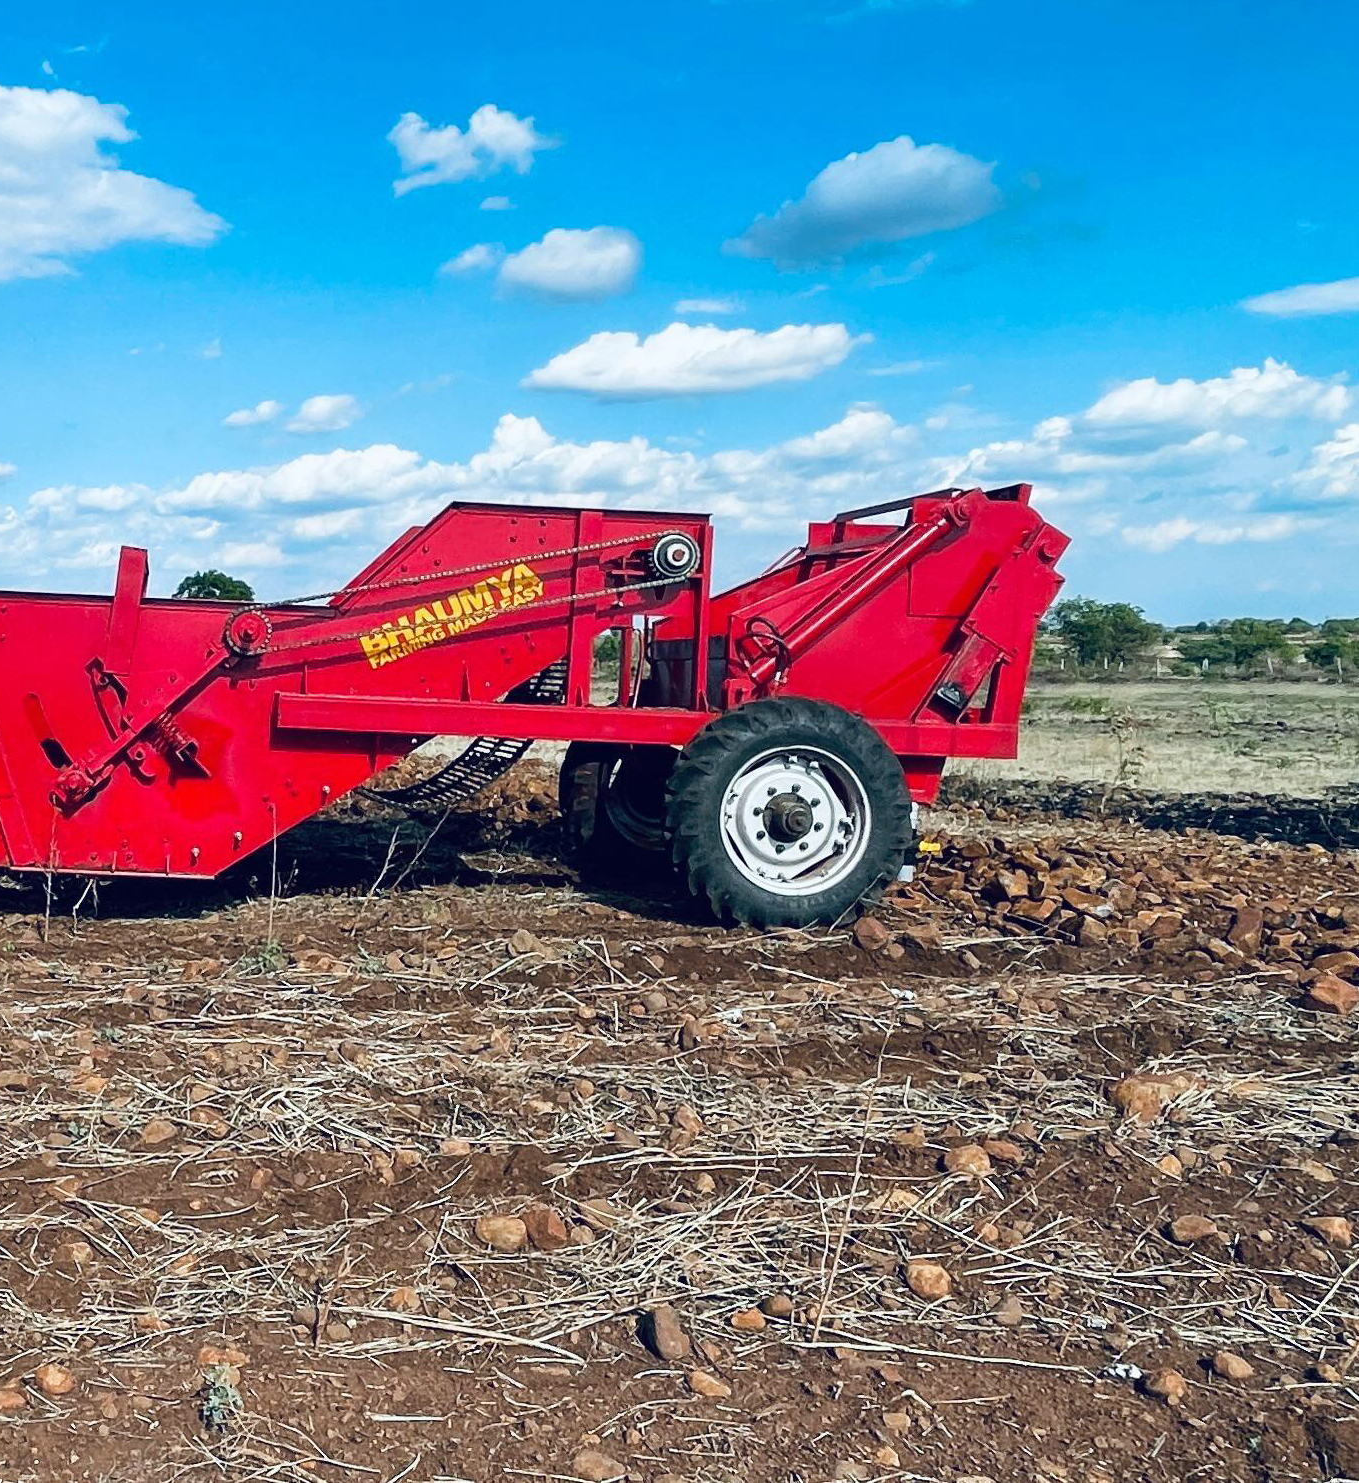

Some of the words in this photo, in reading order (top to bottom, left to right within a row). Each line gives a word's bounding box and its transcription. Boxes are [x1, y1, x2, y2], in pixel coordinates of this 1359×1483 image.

[359, 563, 543, 656] BHAUMYA
[369, 627, 446, 669] FARMING
[449, 604, 499, 635] MADE
[500, 580, 544, 610] EASY
